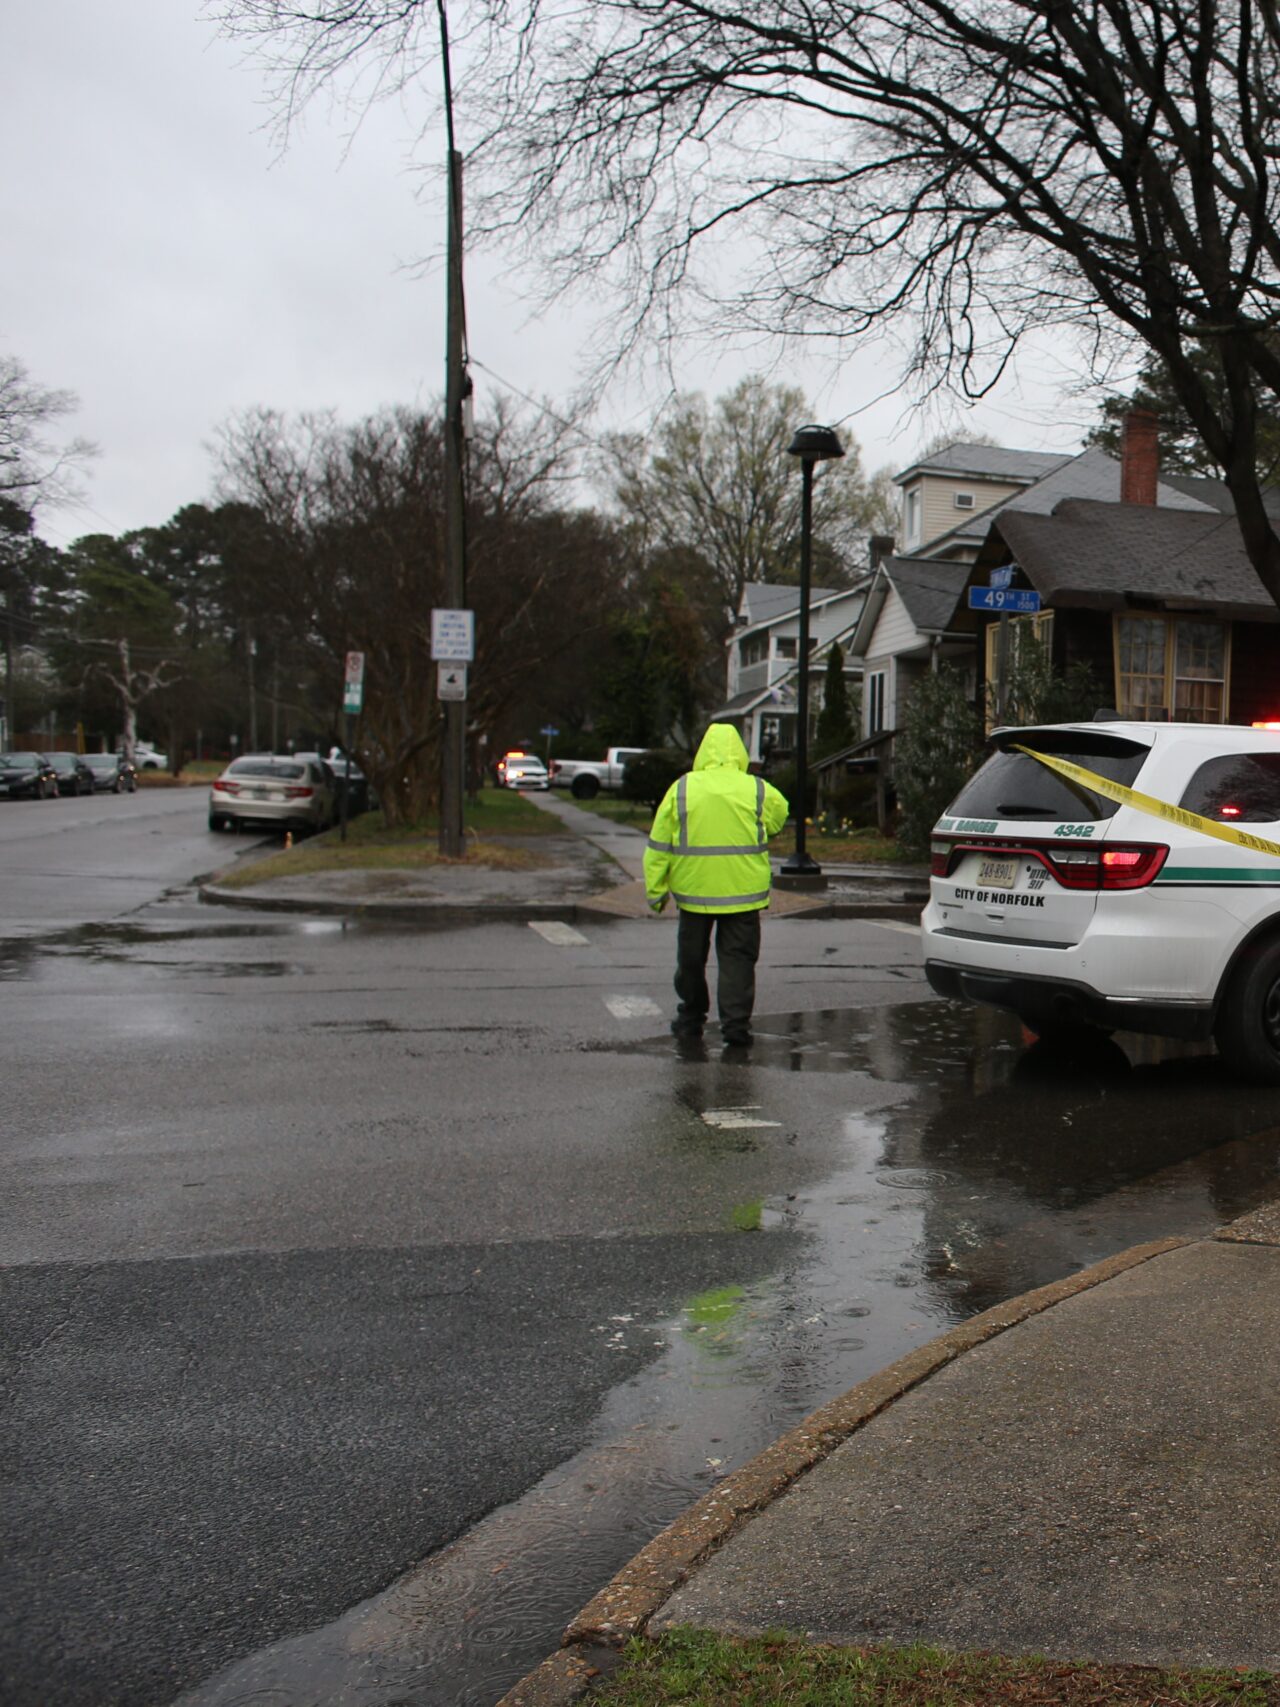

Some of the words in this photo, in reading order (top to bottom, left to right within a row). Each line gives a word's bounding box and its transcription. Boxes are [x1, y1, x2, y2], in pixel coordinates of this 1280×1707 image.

[1053, 824, 1096, 838] 4342
[1027, 879, 1044, 890] 911
[955, 888, 975, 902] CITY
[976, 890, 989, 902] OF
[992, 892, 1046, 907] NORFOLK
